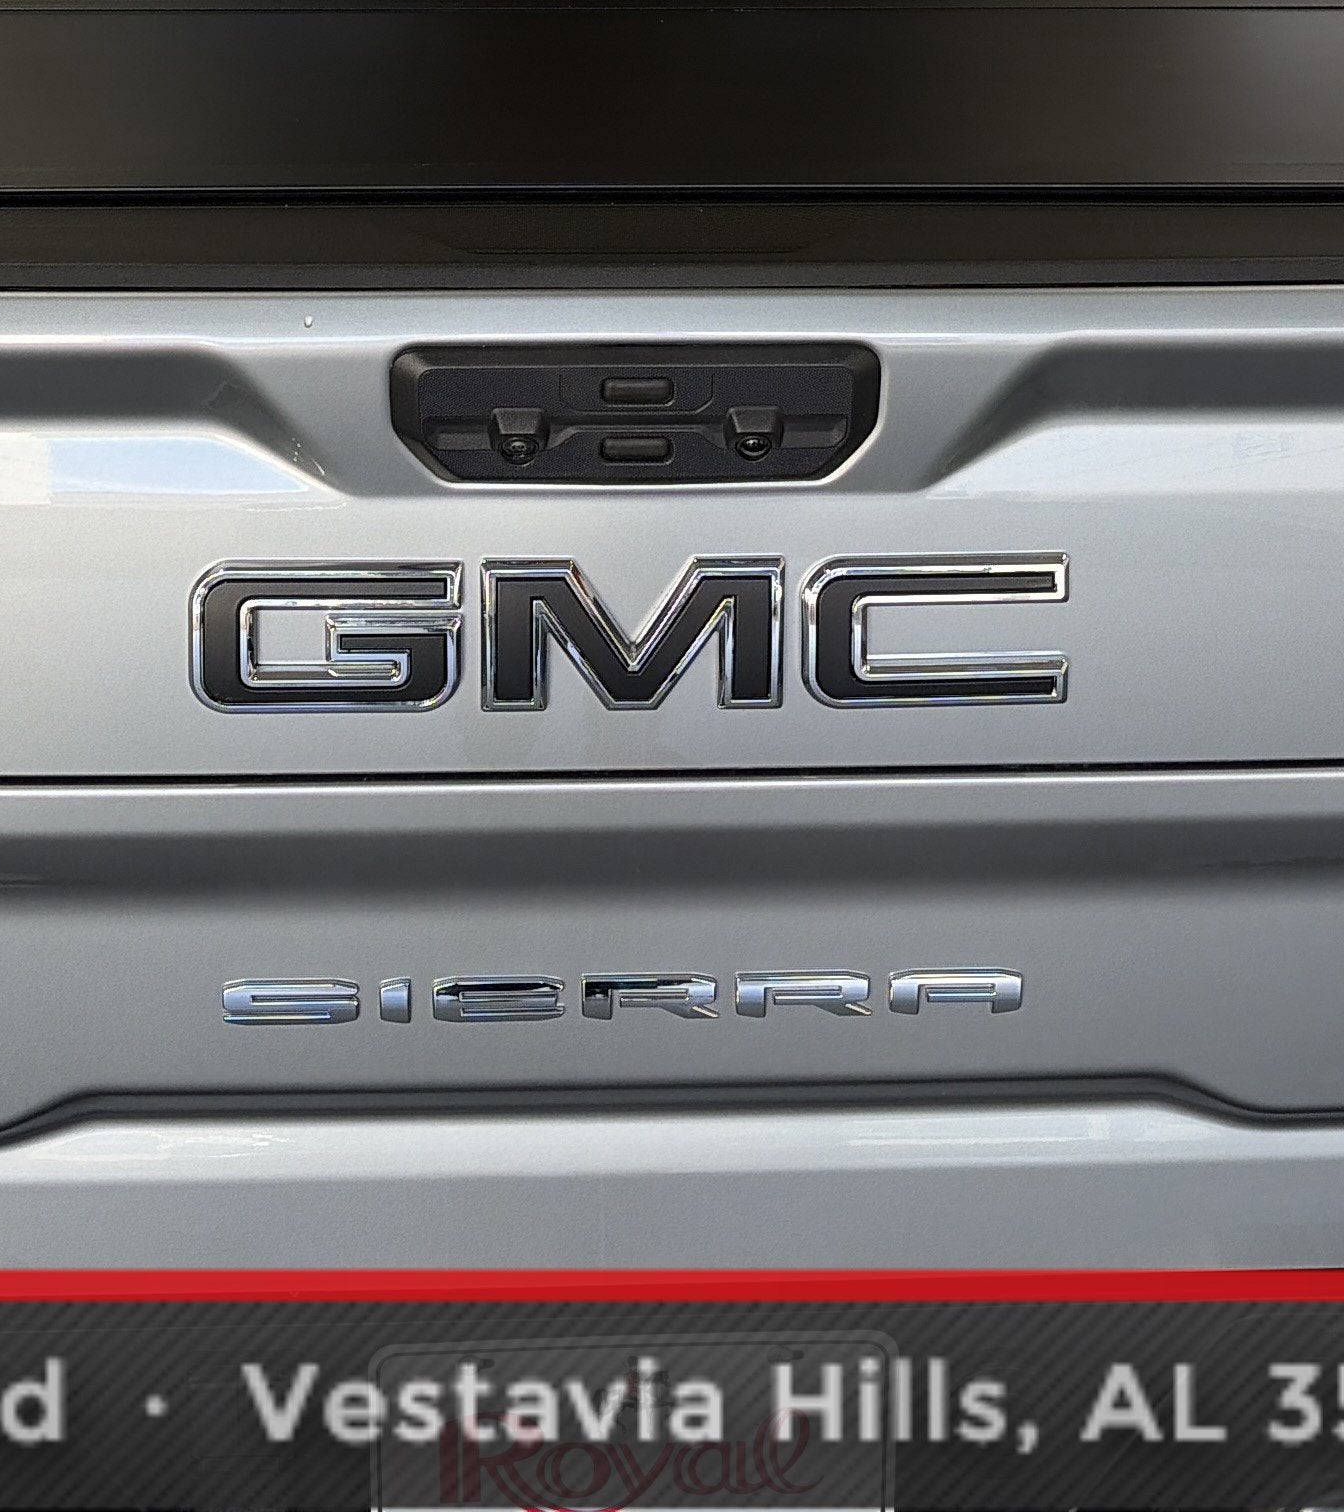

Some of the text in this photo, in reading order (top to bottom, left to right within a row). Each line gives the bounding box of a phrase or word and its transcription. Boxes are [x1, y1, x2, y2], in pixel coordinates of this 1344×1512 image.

[189, 554, 1069, 712] GMC
[221, 968, 1023, 1025] SIERRA
[439, 1410, 826, 1512] Royal
